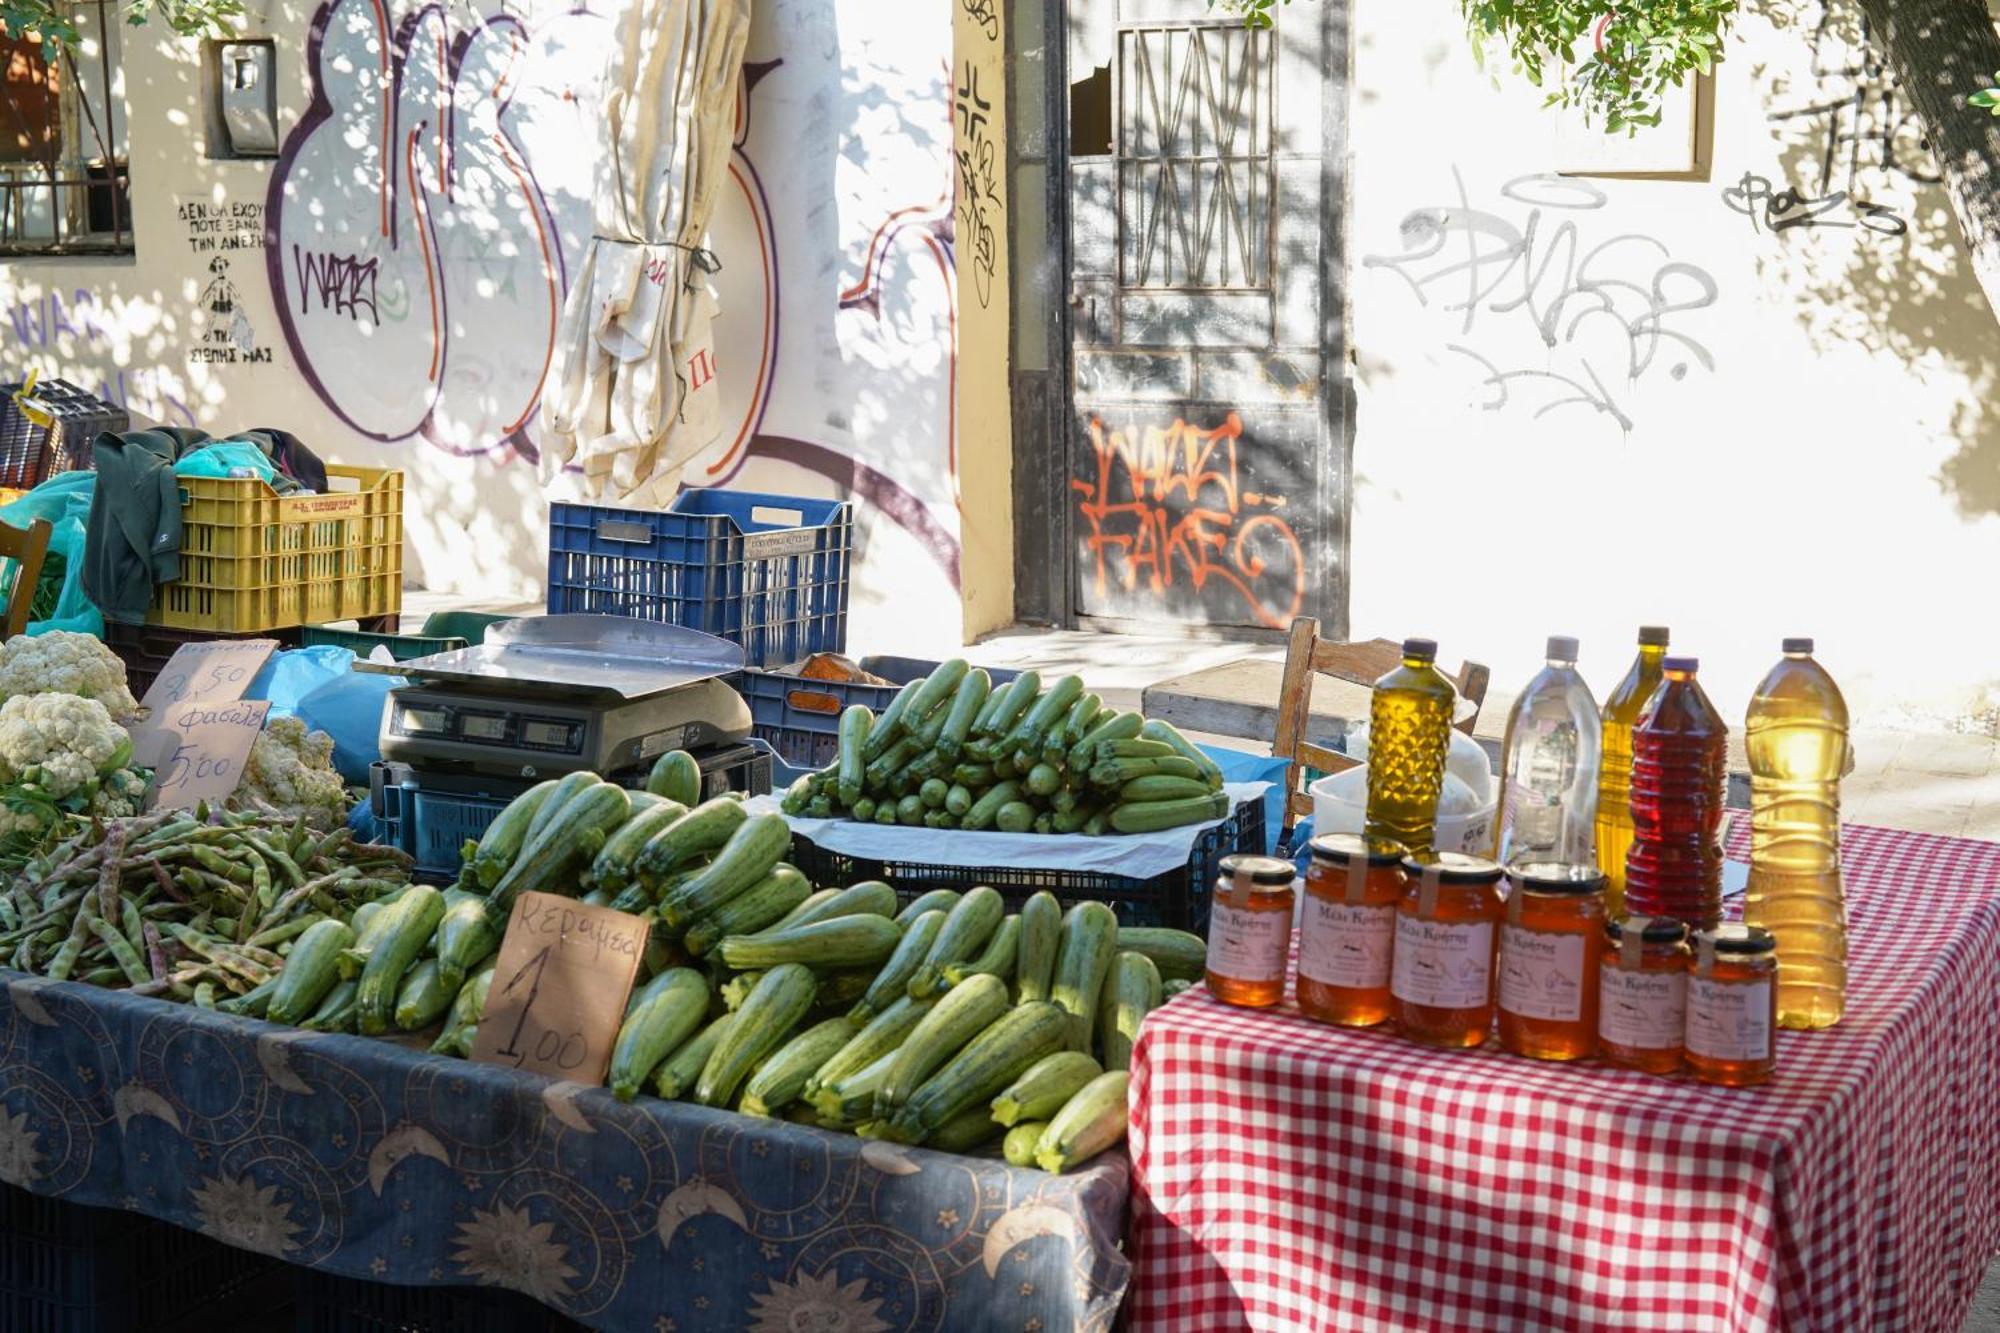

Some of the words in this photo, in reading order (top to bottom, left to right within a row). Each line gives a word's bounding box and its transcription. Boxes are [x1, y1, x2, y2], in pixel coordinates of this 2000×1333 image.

[178, 203, 206, 220] ΔΕΝ
[190, 219, 222, 232] ΠΟΤΕ
[188, 236, 215, 253] ΤΗΝ
[190, 347, 236, 363] ΣΙΩΠΗΣ
[496, 943, 588, 1070] 1,00
